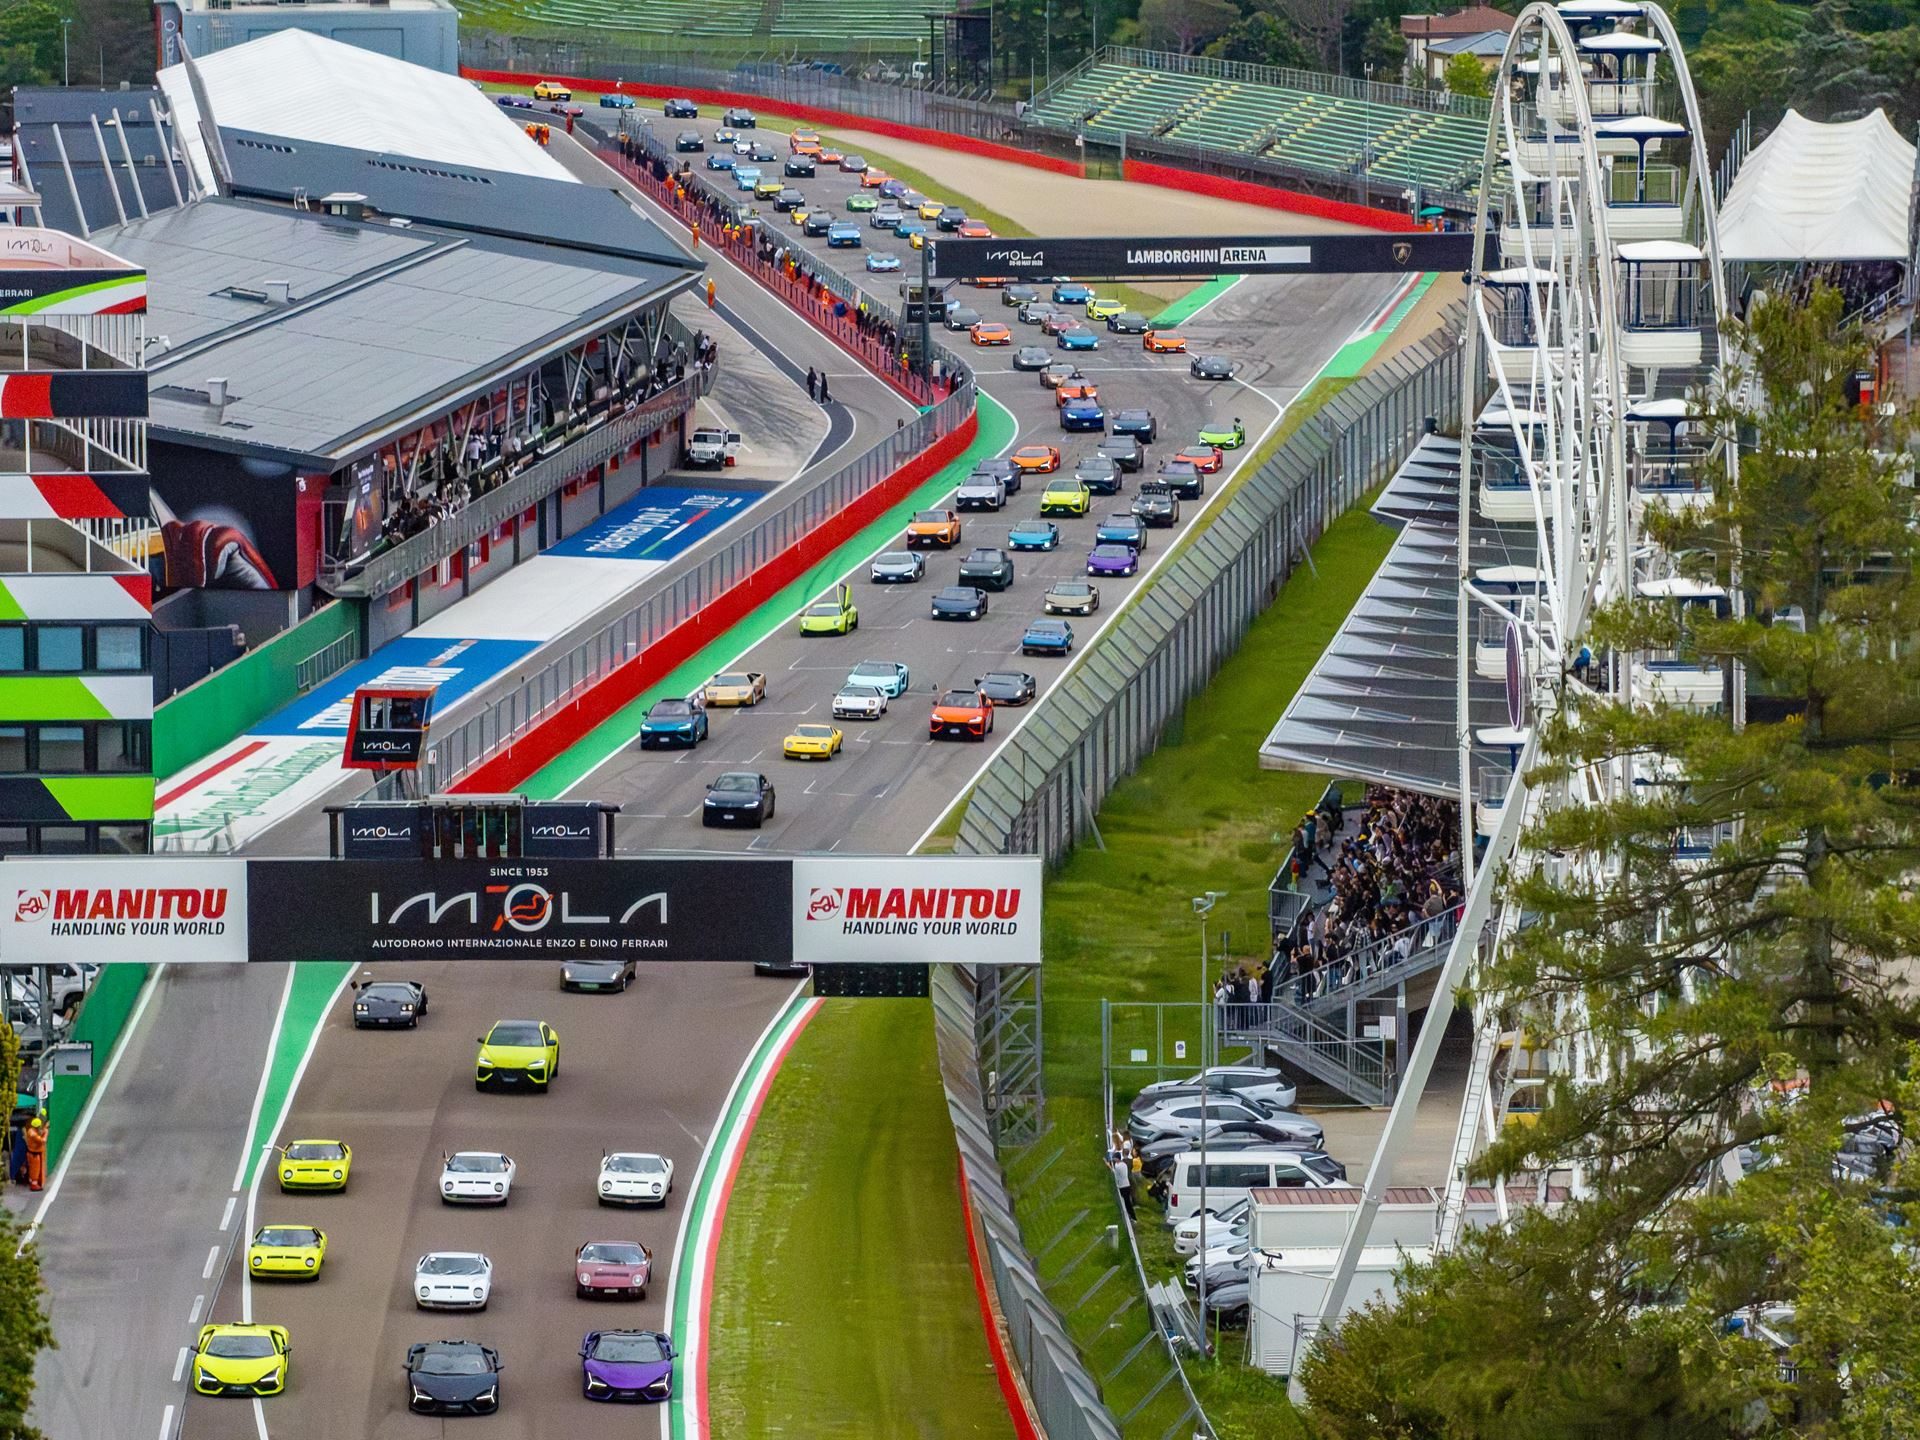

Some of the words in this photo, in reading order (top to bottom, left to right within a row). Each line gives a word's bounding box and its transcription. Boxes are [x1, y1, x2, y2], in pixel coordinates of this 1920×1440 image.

[986, 250, 1043, 261] IMOLA
[1127, 249, 1218, 264] LAMBORGHINI
[1222, 249, 1267, 262] ARENA
[363, 741, 411, 751] IMOLA
[352, 826, 411, 837] IMOLA
[532, 825, 590, 836] IMOLA
[490, 867, 522, 877] SINCE
[526, 867, 549, 877] 1953
[53, 888, 227, 919] MANITOU
[845, 888, 1021, 919] MANITOU
[51, 921, 127, 936] HANDLING
[131, 921, 170, 936] YOUR
[174, 921, 225, 936] WORLD
[842, 920, 919, 936] HANDLING
[923, 920, 962, 936] YOUR
[965, 920, 1017, 936] WORLD
[372, 939, 444, 949] AUTODROMO
[447, 939, 543, 949] INTERNAZIONALE
[546, 939, 576, 949] ENZO
[580, 939, 587, 949] E
[590, 939, 618, 949] DINO
[622, 939, 669, 949] FERRARI
